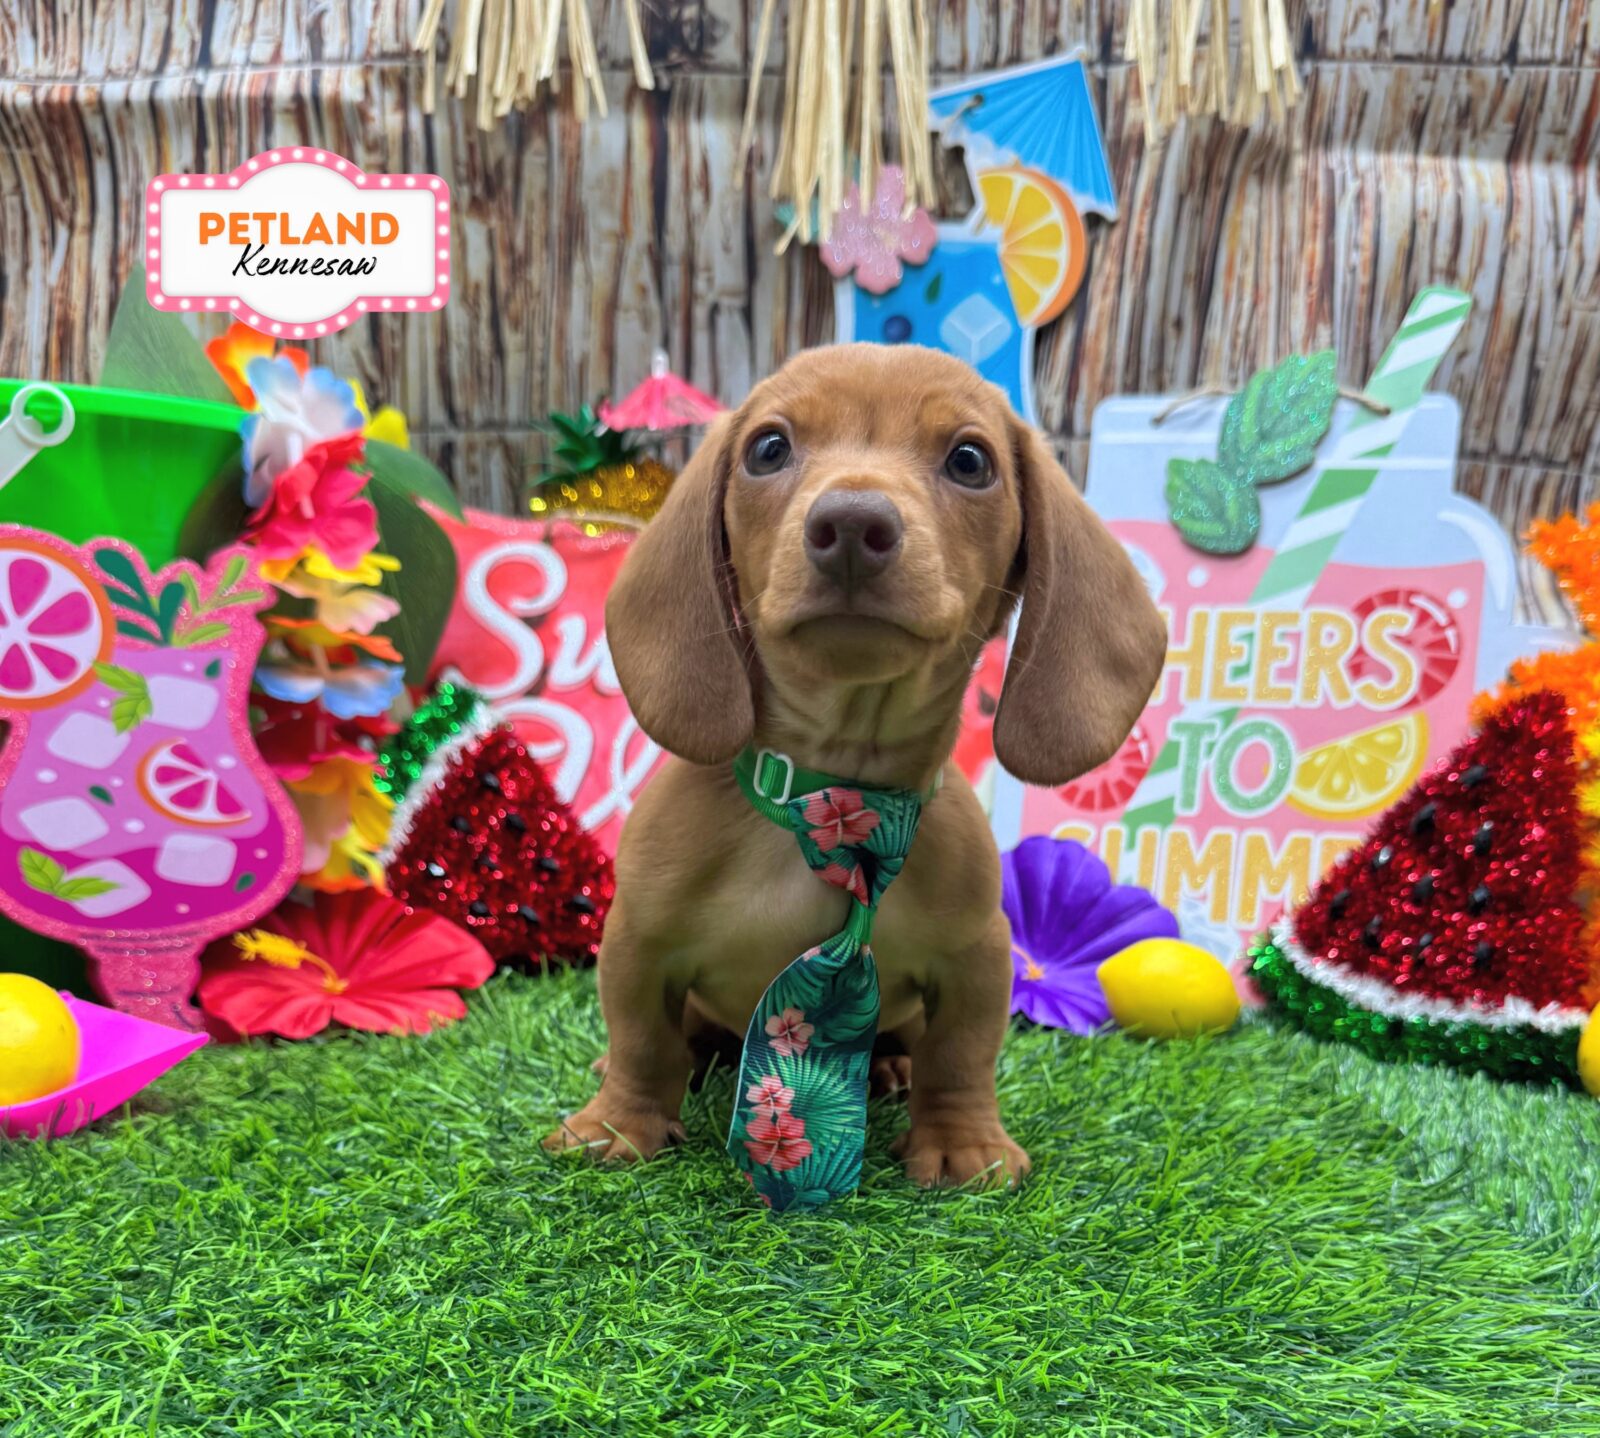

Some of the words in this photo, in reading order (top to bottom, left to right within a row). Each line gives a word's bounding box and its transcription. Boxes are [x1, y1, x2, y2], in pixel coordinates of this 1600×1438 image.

[1150, 609, 1418, 704] HEERS
[1171, 720, 1294, 813] TO
[1053, 825, 1364, 924] UMM
